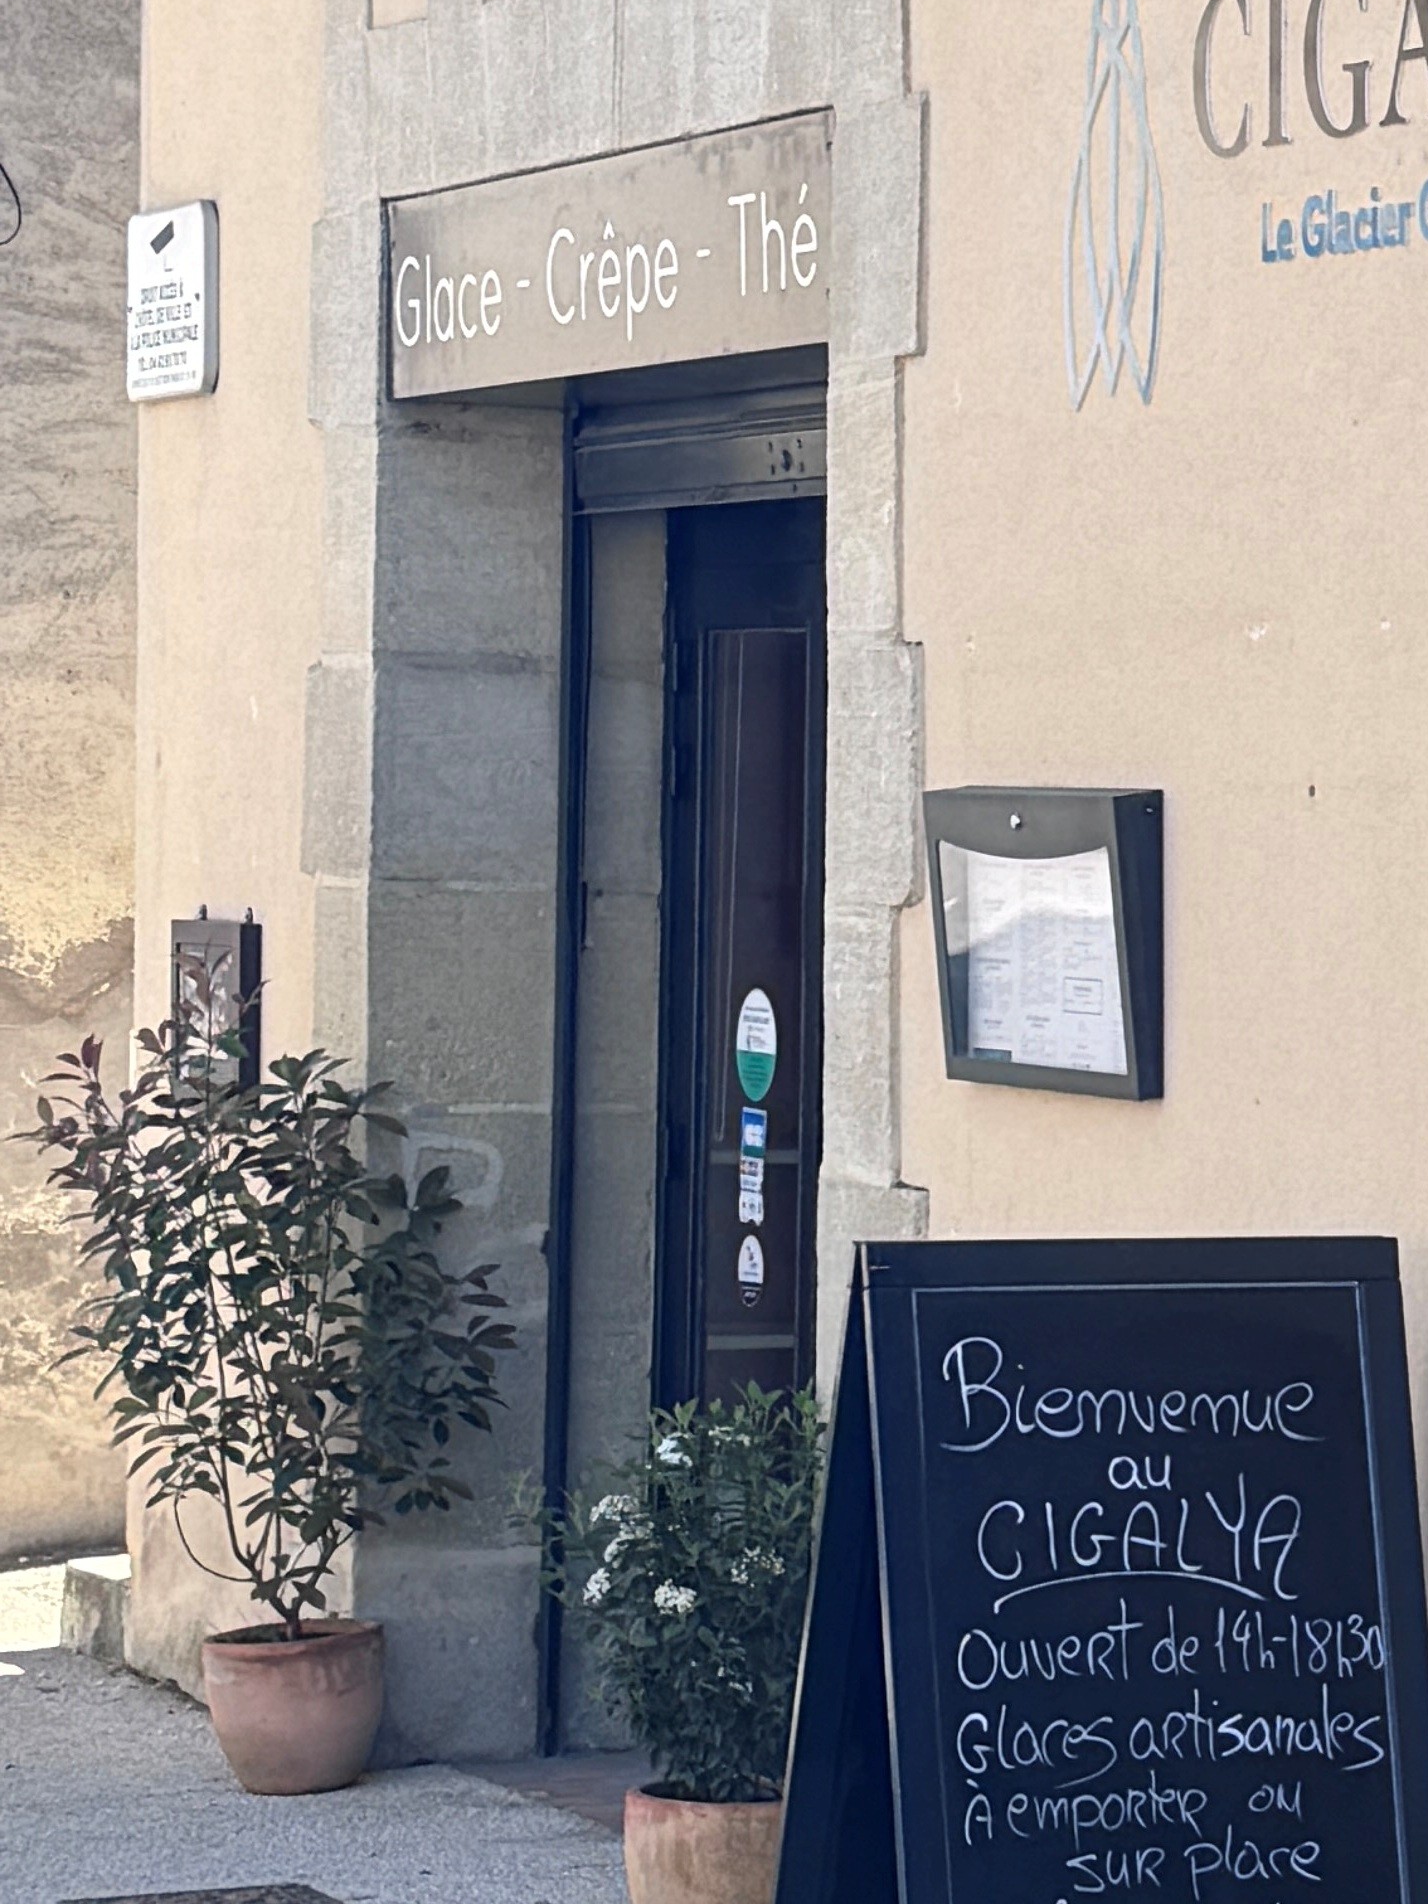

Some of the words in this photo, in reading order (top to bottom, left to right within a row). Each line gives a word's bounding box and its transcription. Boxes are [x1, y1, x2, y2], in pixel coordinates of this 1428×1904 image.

[395, 254, 503, 348] Glace
[545, 221, 679, 342] Crêpe
[726, 182, 818, 297] Thé
[1260, 201, 1295, 263] Le
[1300, 186, 1416, 260] Glacier
[940, 1336, 1326, 1452] Bienvenue
[1108, 1454, 1172, 1491] au
[977, 1472, 1301, 1600] CIGALYA
[956, 1597, 1143, 1690] Ouvert
[1151, 1605, 1199, 1676] de
[956, 1703, 1118, 1789] Glaces
[1129, 1682, 1386, 1771] artisanales
[964, 1778, 993, 1845] À
[1006, 1769, 1207, 1850] emporter
[1248, 1780, 1301, 1822] ou
[1066, 1846, 1166, 1893] sur
[1184, 1824, 1321, 1901] place
